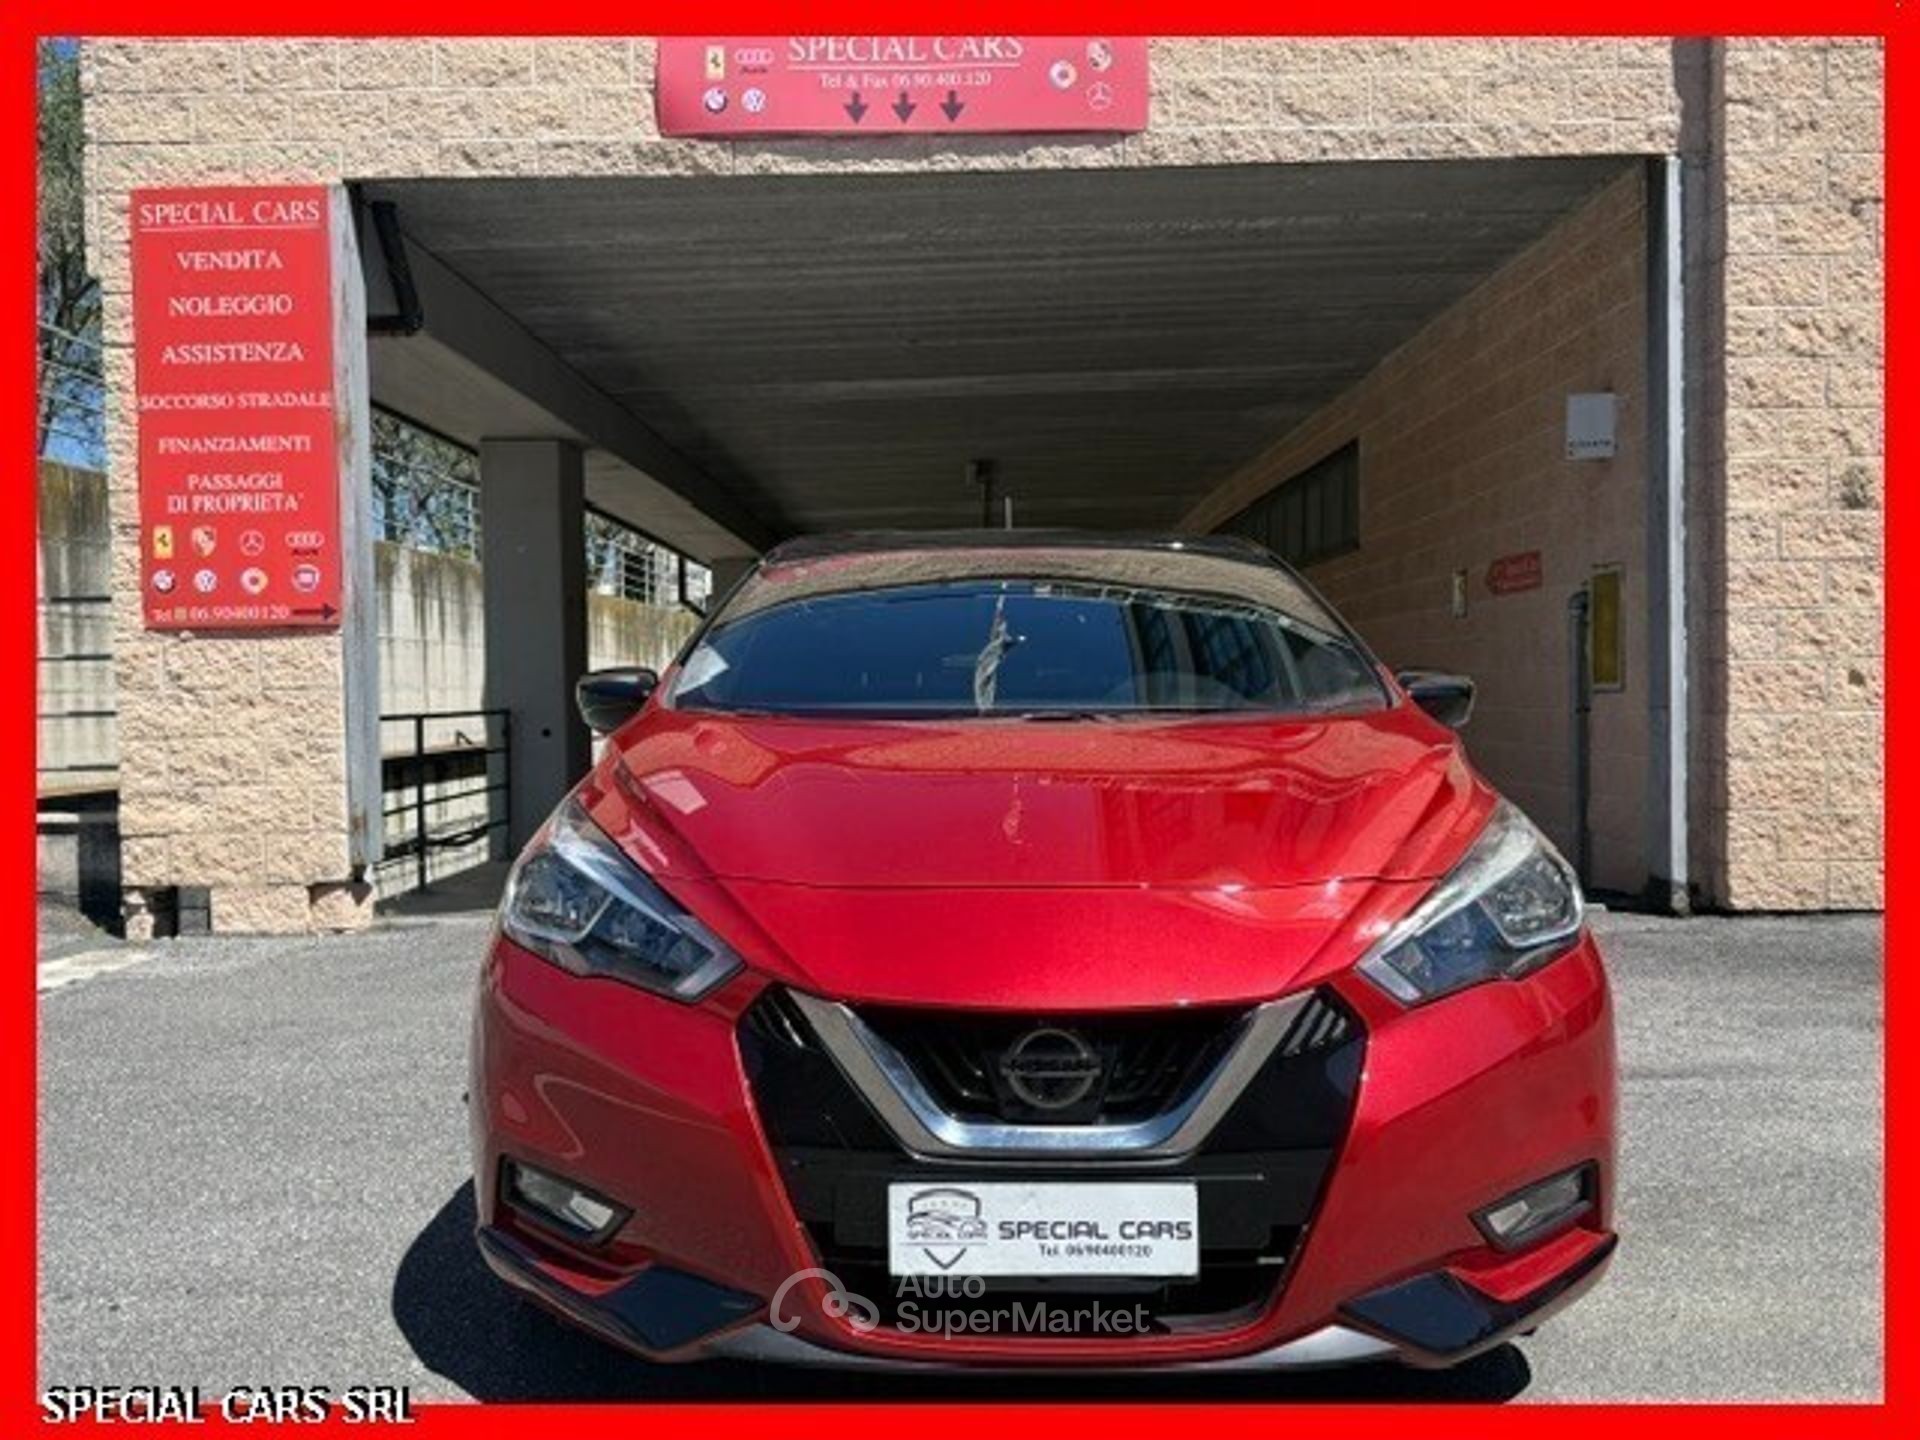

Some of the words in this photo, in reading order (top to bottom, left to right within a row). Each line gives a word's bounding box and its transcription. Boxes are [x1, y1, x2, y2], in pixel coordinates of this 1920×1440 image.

[787, 37, 926, 61] SPECIAL
[933, 37, 1024, 59] CARS
[821, 73, 842, 88] Tel
[863, 73, 888, 88] Fax
[139, 202, 244, 225] SPECIAL
[252, 200, 320, 222] CARS
[176, 250, 283, 271] VENDITA
[168, 294, 293, 317] NOLEGGIO
[161, 342, 304, 365] ASSISTENZA
[140, 393, 235, 410] SOCCORSO
[238, 391, 331, 408] STRADALE
[158, 434, 312, 454] FINANZIAMENTI
[187, 472, 283, 490] PASSAGGI
[167, 495, 188, 514] DI
[998, 1220, 1109, 1240] SPECIAL
[1119, 1220, 1192, 1240] CARS
